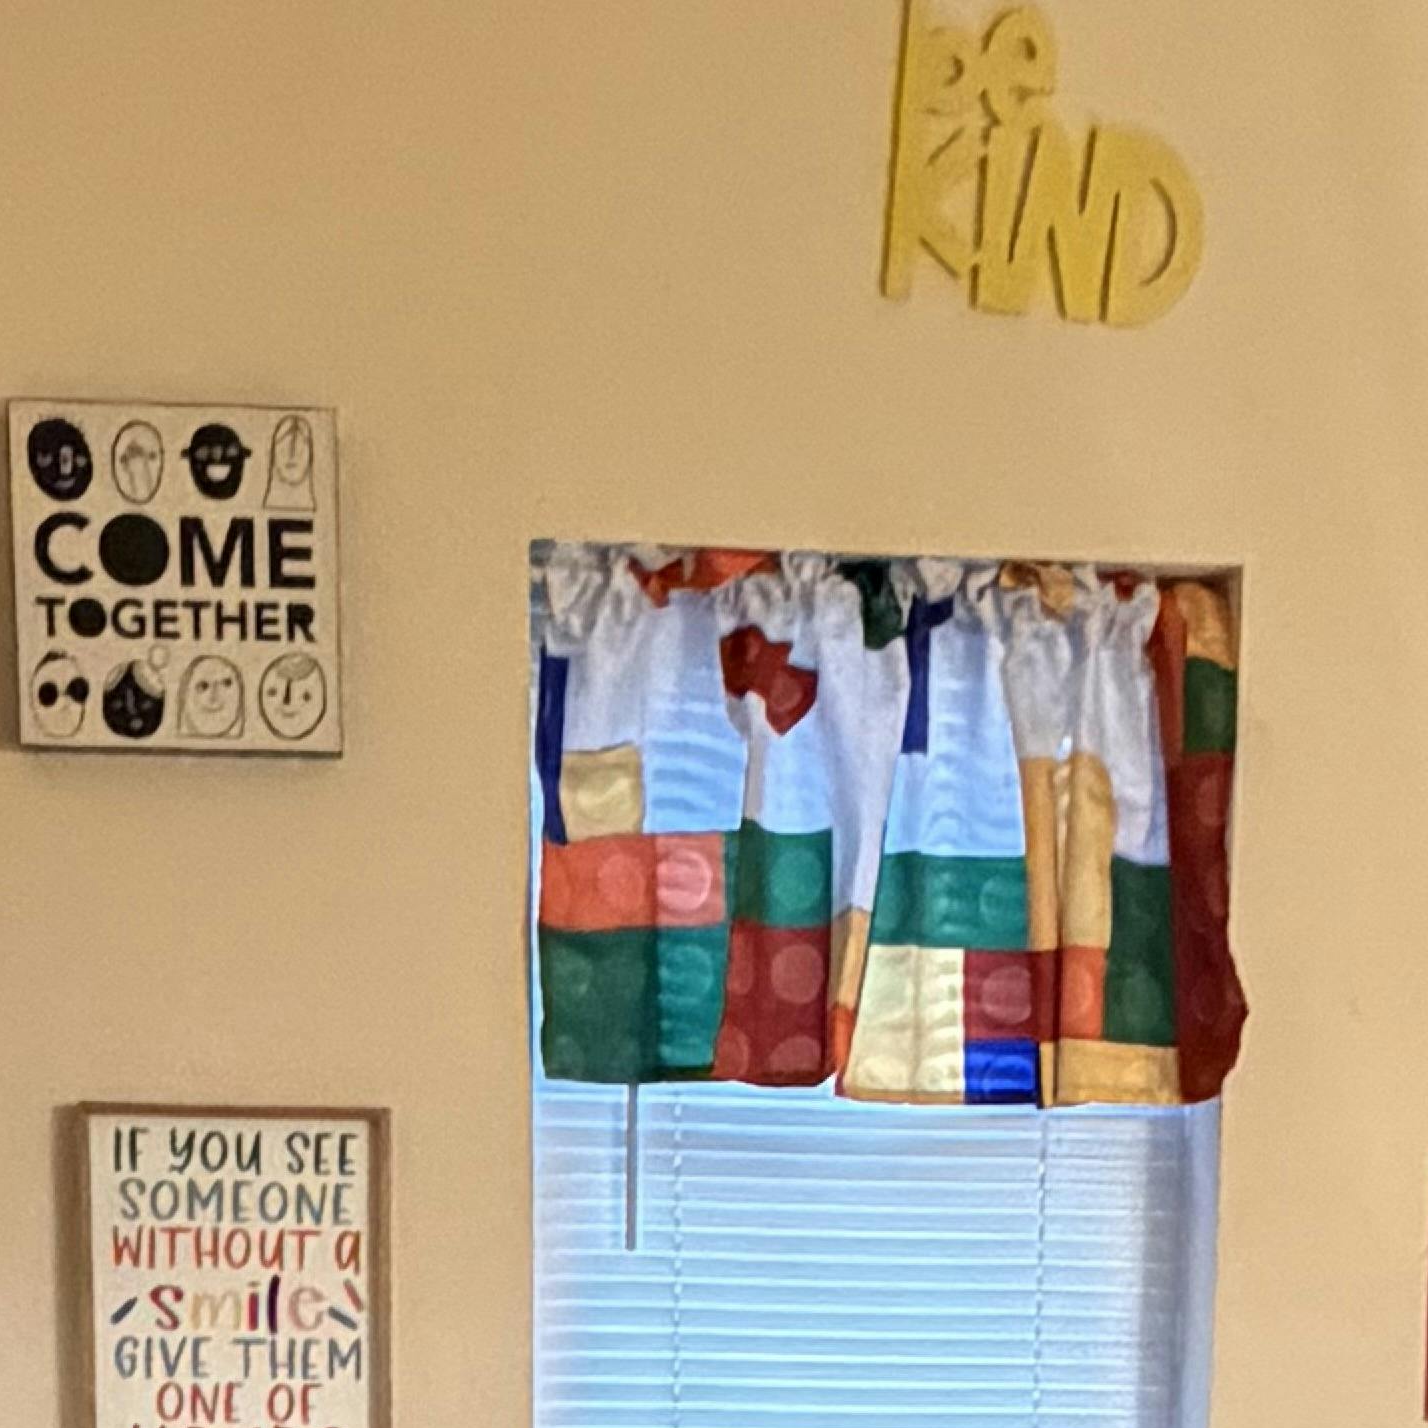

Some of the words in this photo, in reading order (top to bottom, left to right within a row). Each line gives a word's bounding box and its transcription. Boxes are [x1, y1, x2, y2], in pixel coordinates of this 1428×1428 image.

[897, 0, 1060, 116] be
[879, 112, 1206, 329] KIND
[33, 511, 317, 589] COME
[35, 596, 317, 643] TOGETHER
[112, 1126, 150, 1174] IF
[169, 1128, 262, 1176] YOU
[284, 1130, 358, 1177] SEE
[118, 1178, 355, 1226] SOMEONE
[111, 1225, 321, 1271] WITHOUT
[113, 1335, 213, 1379] GIVE
[231, 1337, 362, 1381] THEM
[156, 1381, 243, 1424] ONE
[266, 1382, 323, 1425] OF
